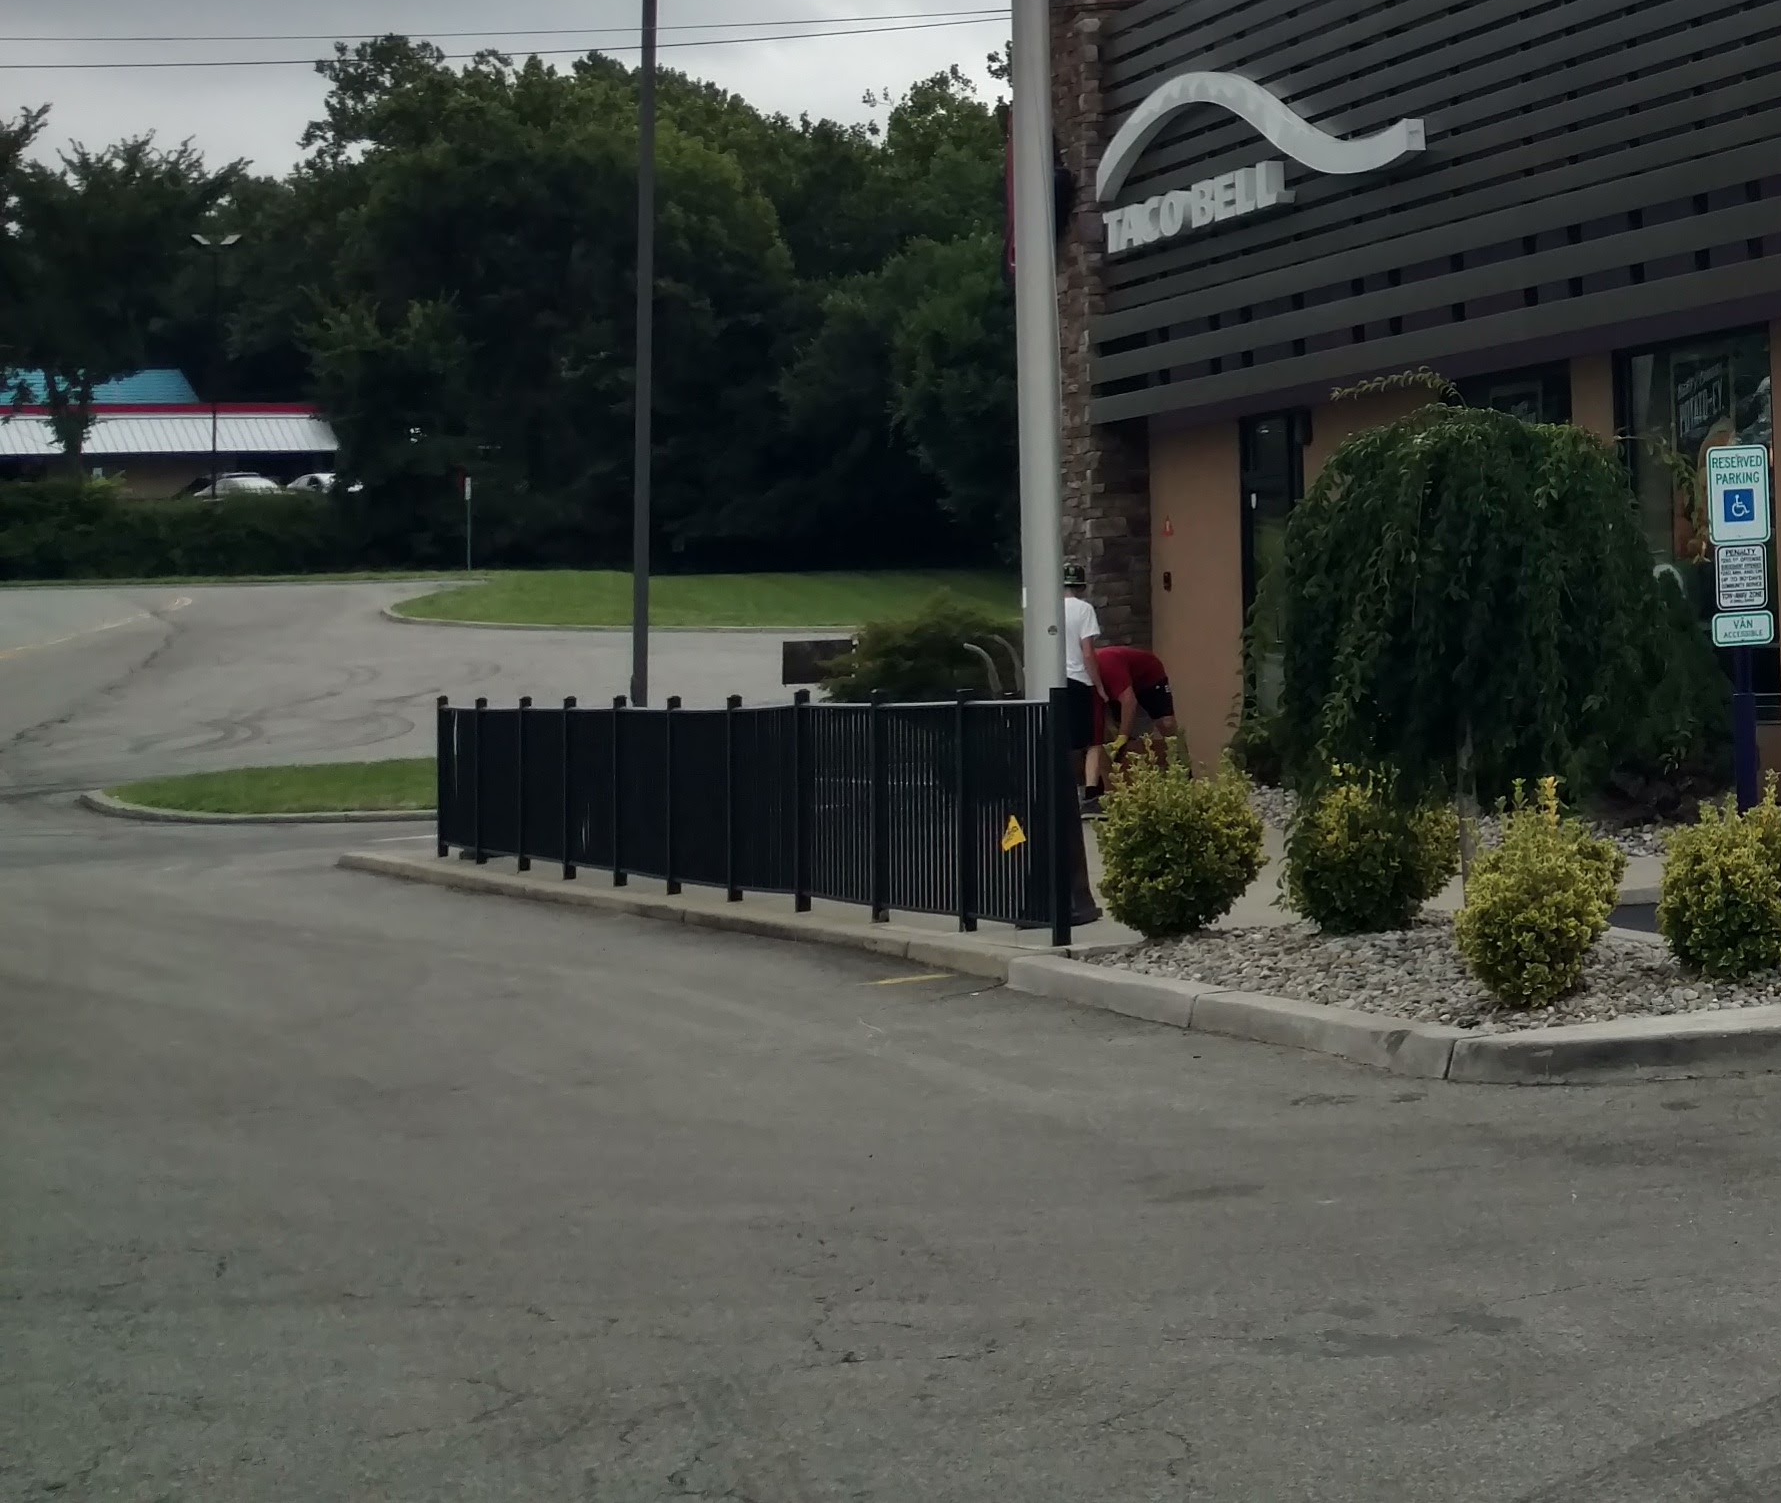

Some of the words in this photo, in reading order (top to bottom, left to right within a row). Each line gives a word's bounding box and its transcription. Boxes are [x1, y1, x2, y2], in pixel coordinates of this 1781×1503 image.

[1103, 190, 1193, 254] TACO
[1191, 160, 1296, 228] BELL
[1712, 455, 1762, 469] RESERVED
[1716, 471, 1760, 485] PARKING
[1725, 548, 1756, 557] PENALTY
[1733, 619, 1753, 629] VAN
[1723, 630, 1763, 638] ACCESSIBLE
